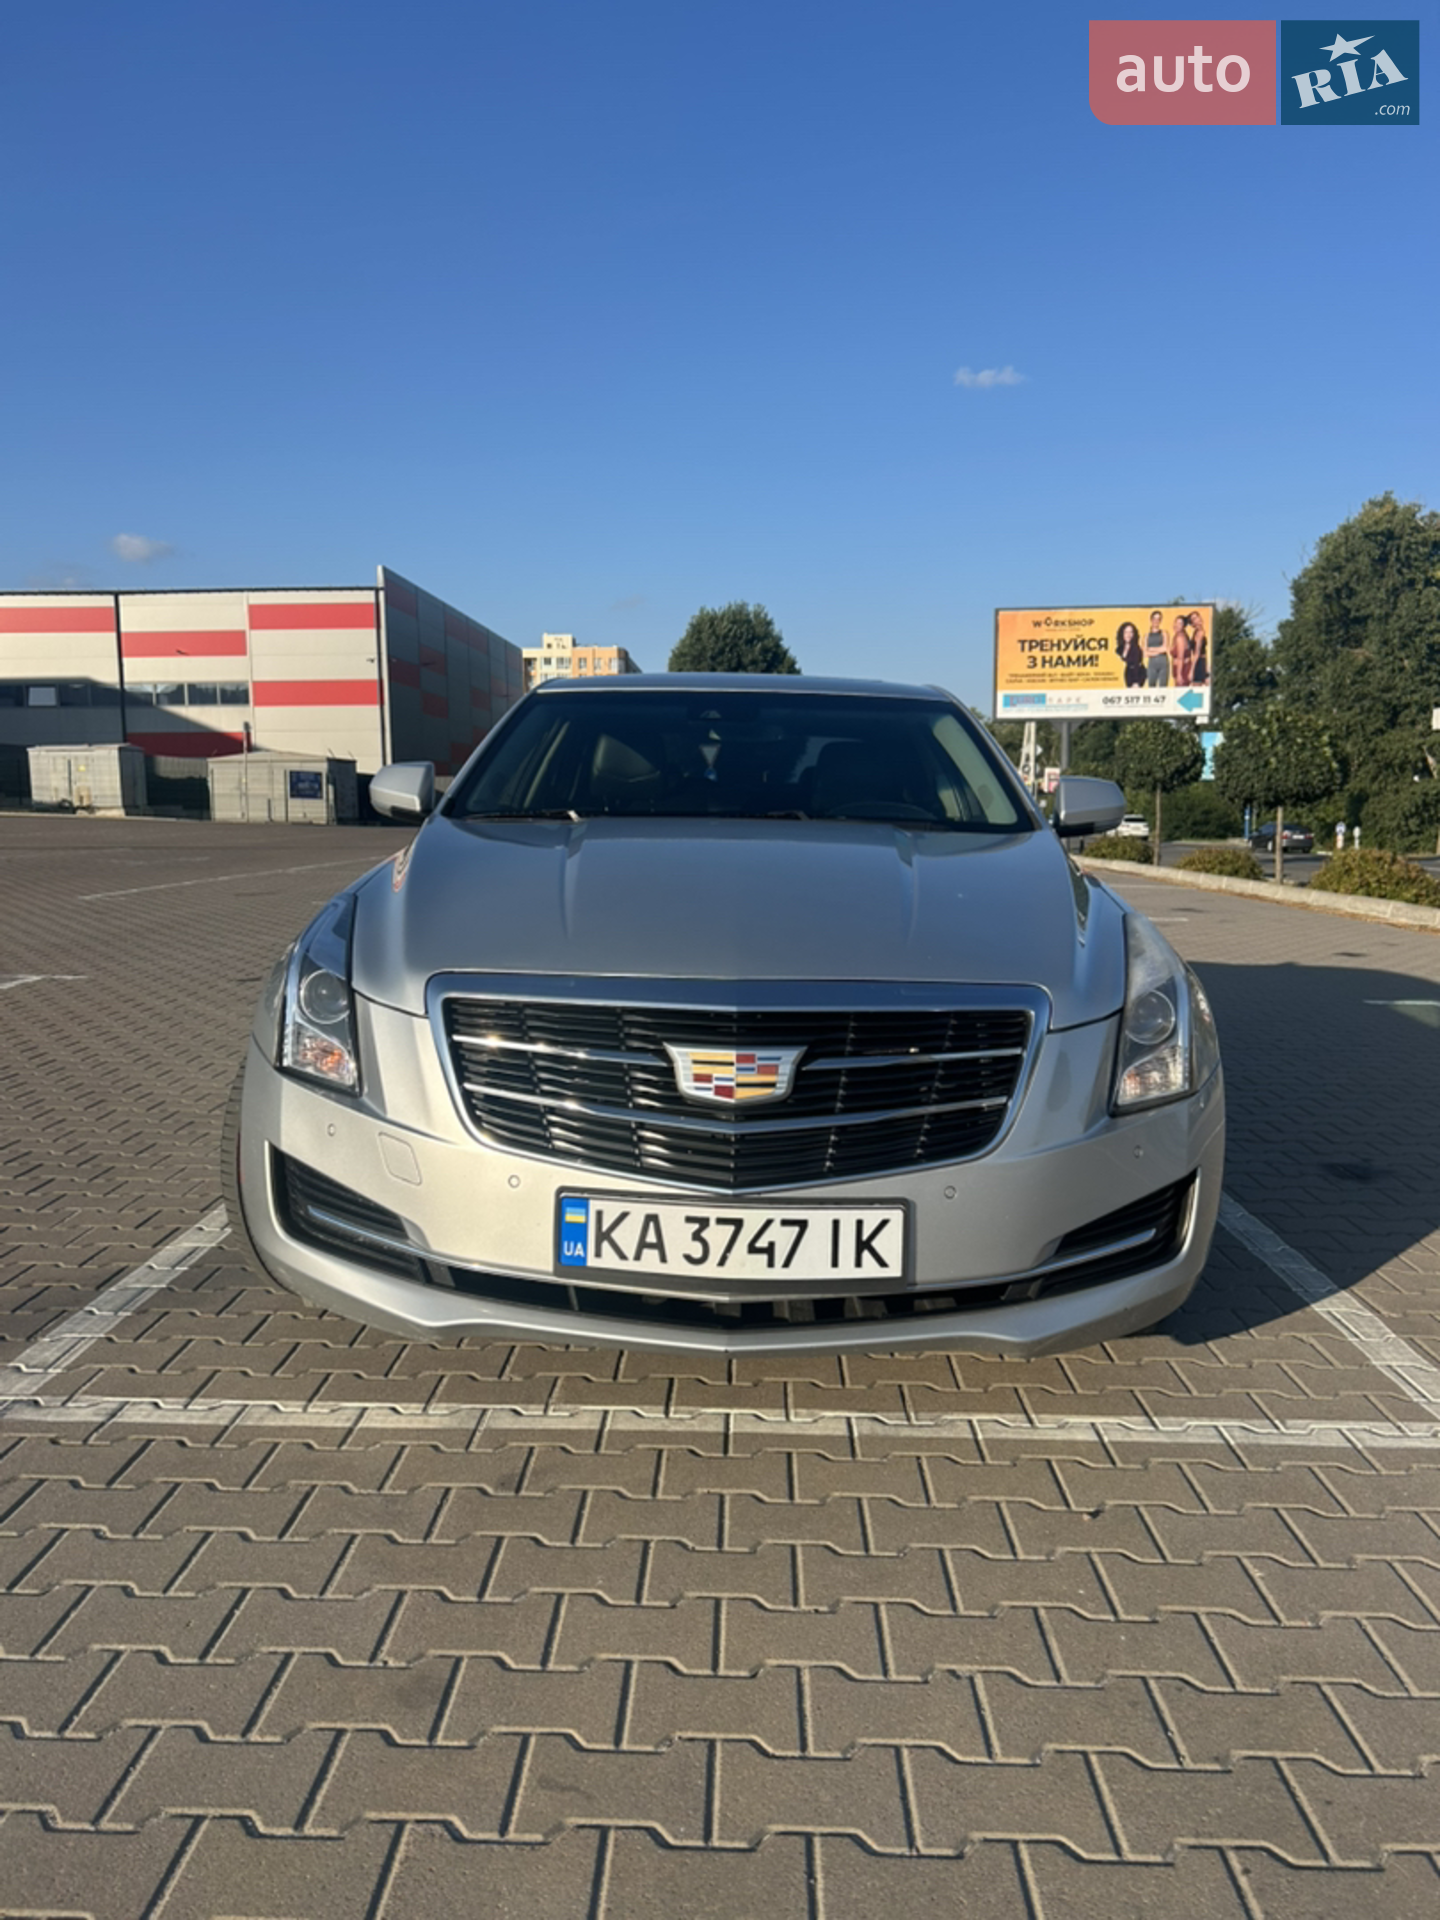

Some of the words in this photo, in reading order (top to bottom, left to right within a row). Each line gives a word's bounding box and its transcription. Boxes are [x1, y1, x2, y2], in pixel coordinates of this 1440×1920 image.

[1017, 634, 1109, 653] ТРЕНУЙСЯ
[1041, 654, 1099, 669] НАМИ!
[1102, 695, 1122, 705] 067
[1124, 695, 1141, 705] 517
[594, 1208, 668, 1264] KA
[682, 1215, 809, 1269] 3747
[830, 1218, 891, 1269] IK
[563, 1241, 585, 1258] UA
